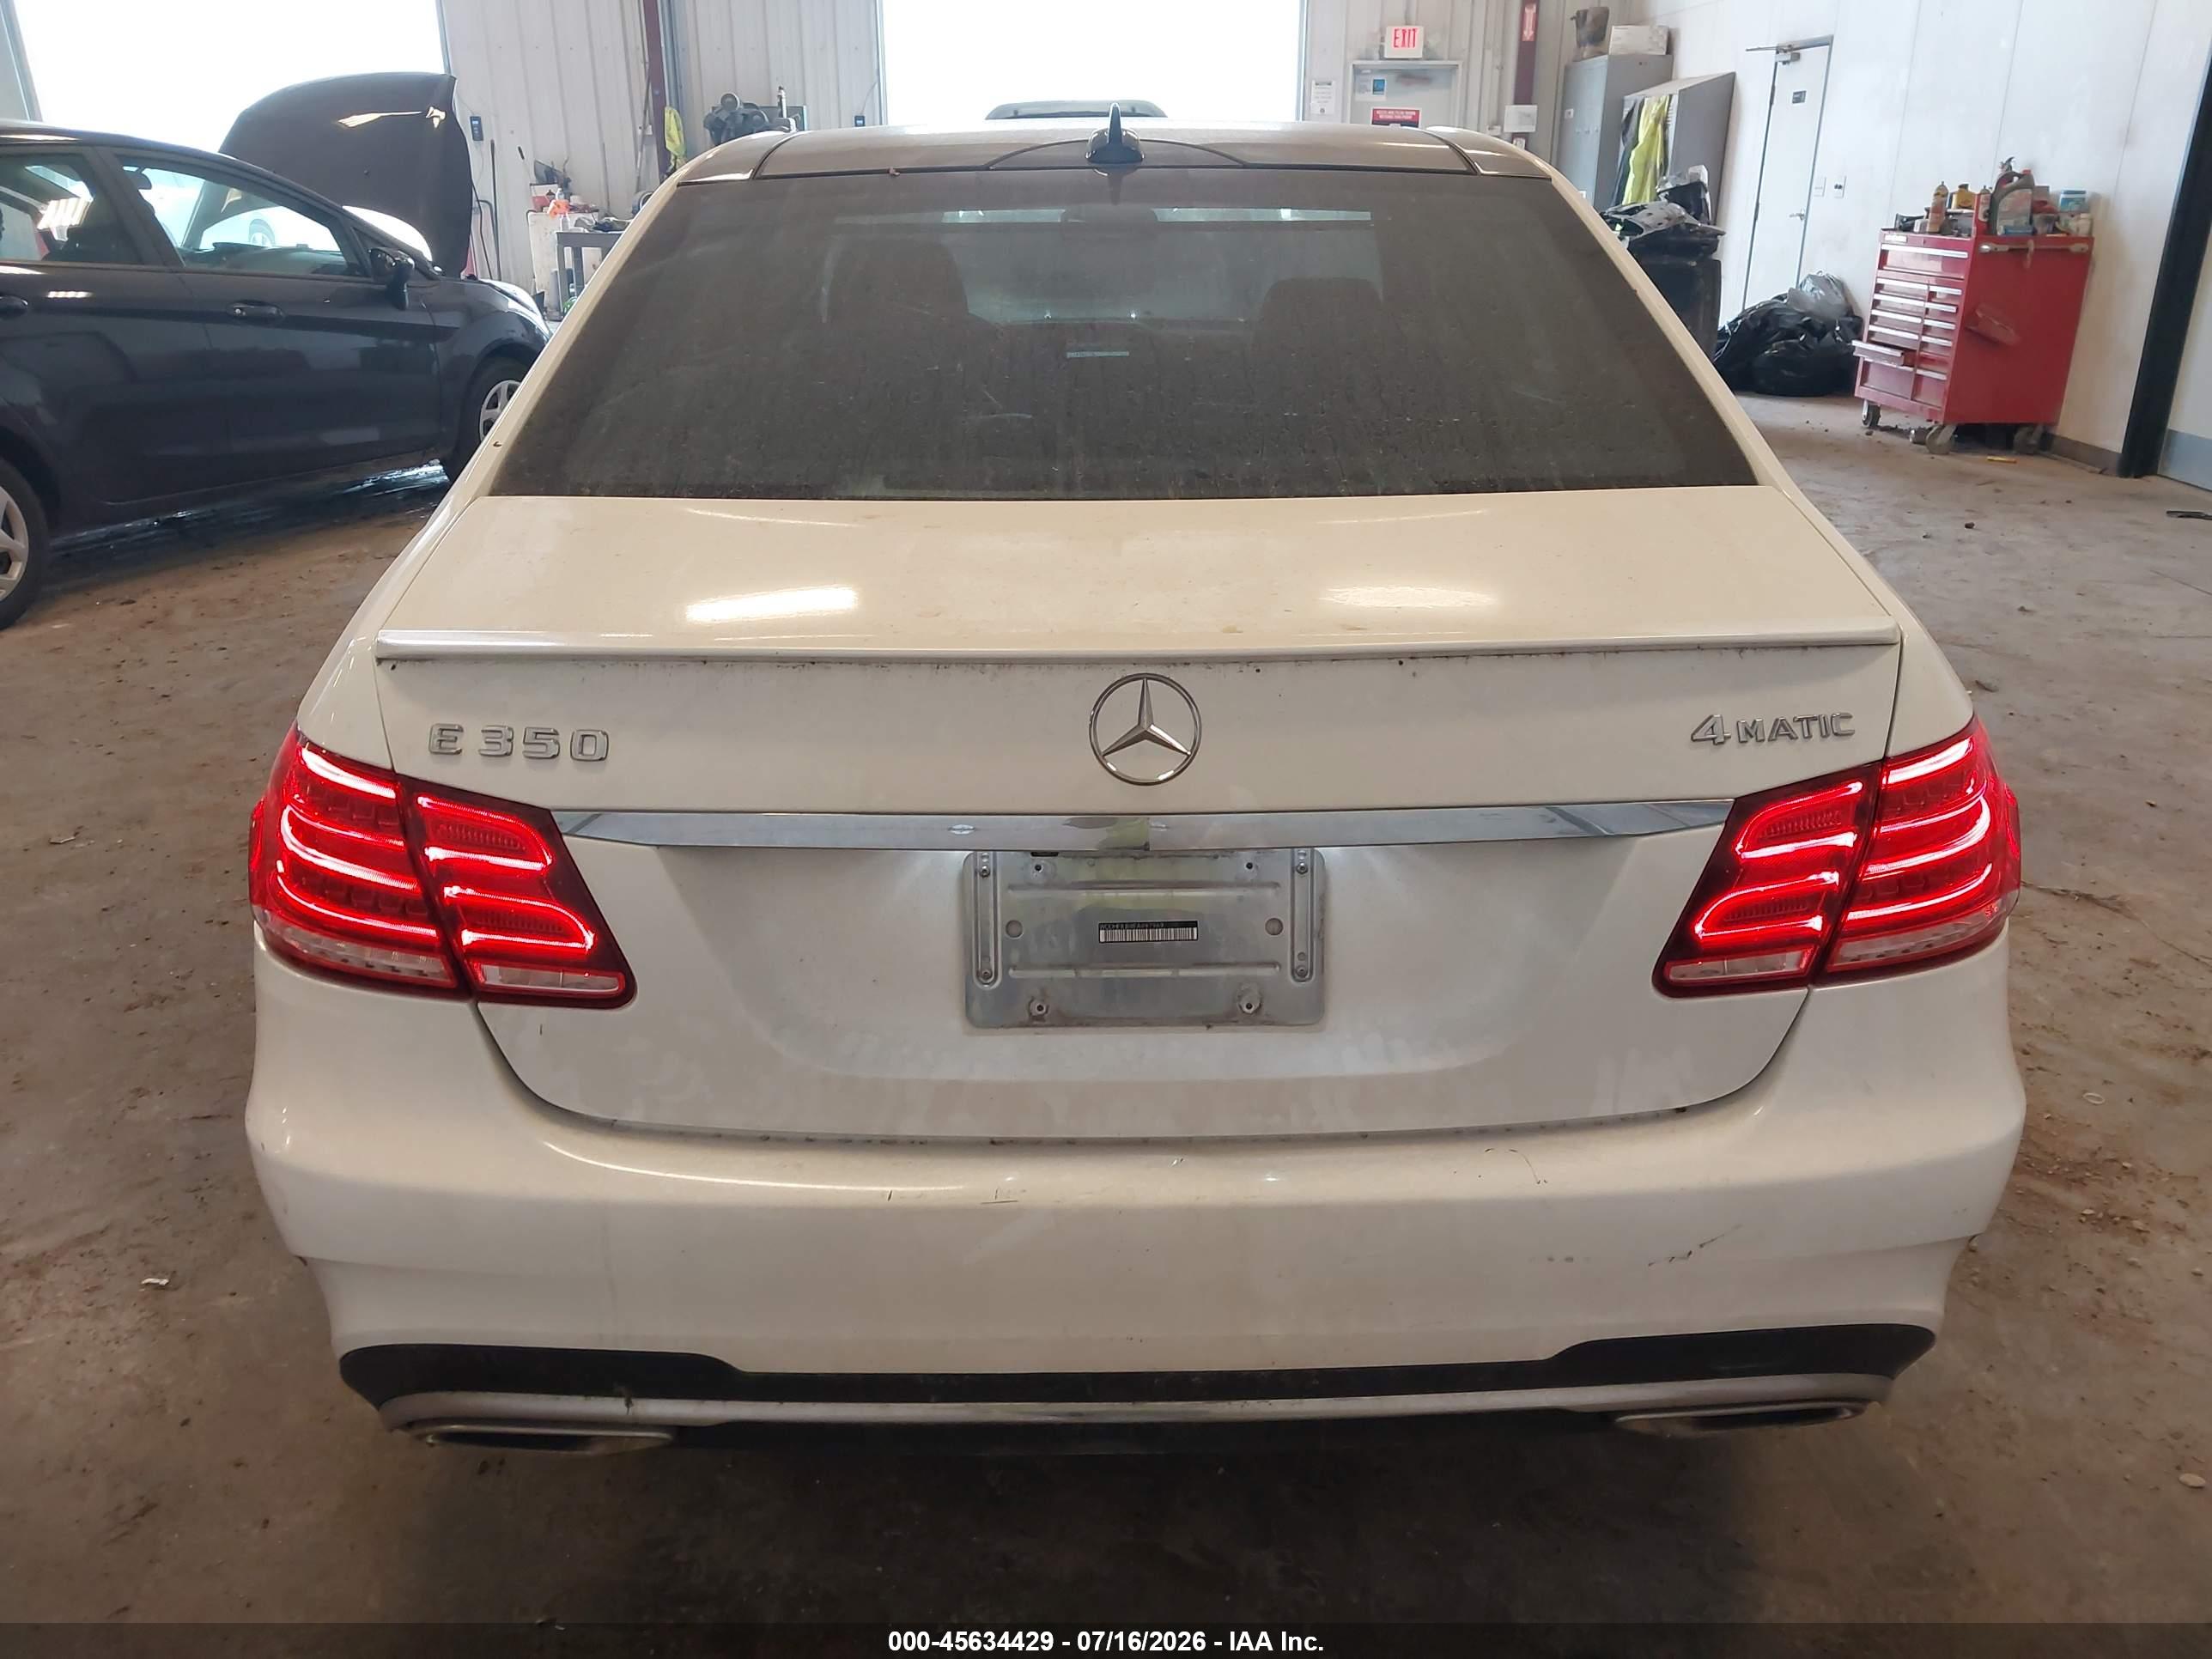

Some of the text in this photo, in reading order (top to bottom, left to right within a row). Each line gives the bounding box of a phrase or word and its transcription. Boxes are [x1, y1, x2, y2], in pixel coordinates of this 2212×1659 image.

[1394, 28, 1418, 48] EXIT
[428, 723, 610, 762] E 350
